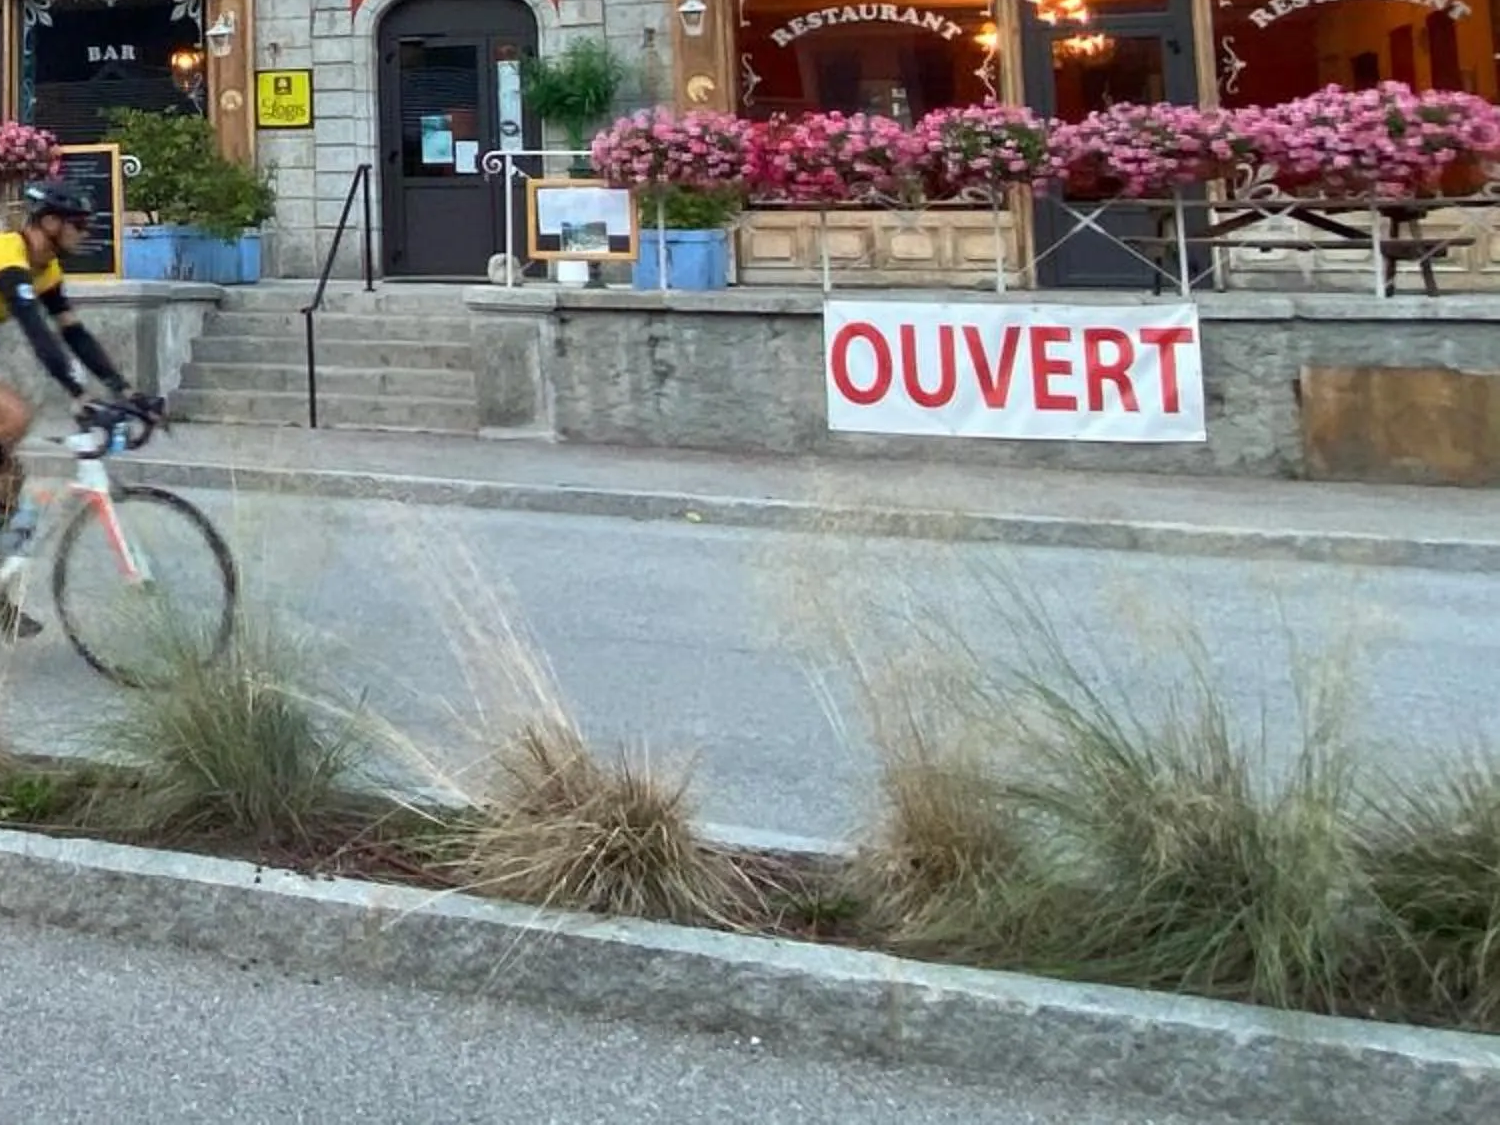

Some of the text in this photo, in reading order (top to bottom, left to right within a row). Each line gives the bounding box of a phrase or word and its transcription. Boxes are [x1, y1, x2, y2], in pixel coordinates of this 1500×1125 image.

[770, 3, 963, 48] RESTAURANT
[87, 44, 136, 62] BAR
[831, 321, 1194, 413] OUVERT
